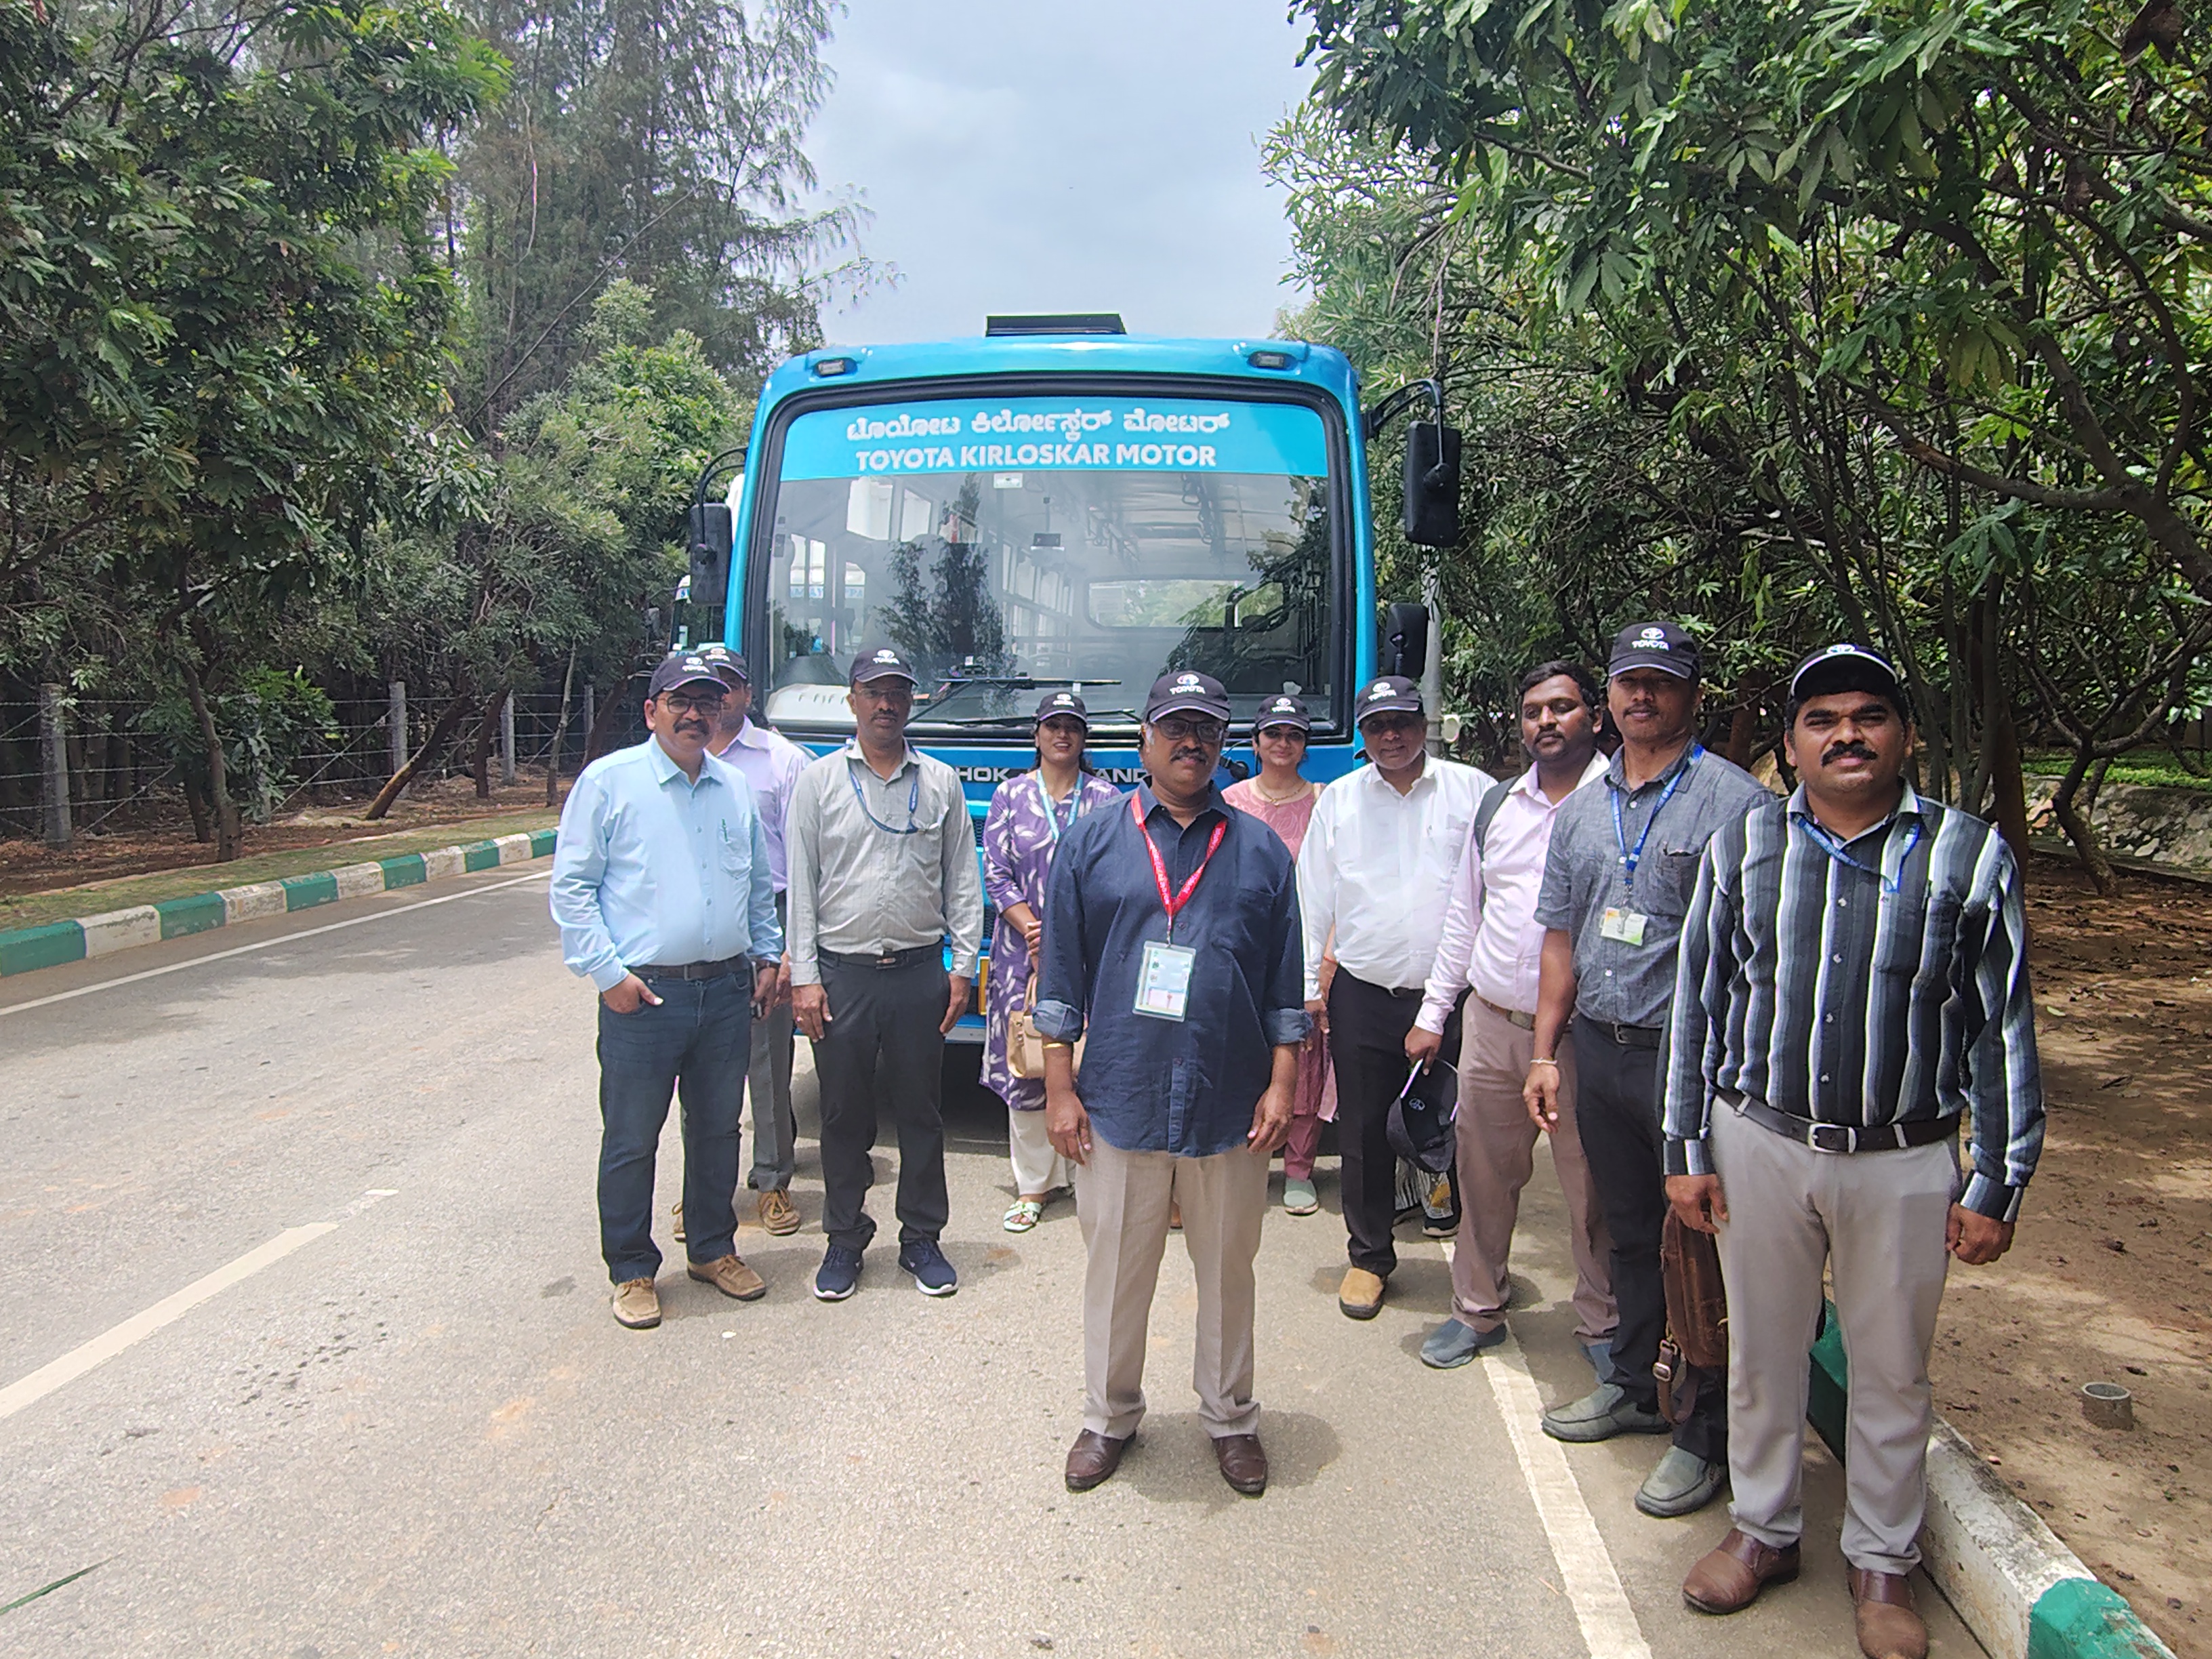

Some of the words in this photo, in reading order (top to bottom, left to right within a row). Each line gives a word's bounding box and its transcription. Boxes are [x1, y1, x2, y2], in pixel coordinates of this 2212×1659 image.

[856, 447, 955, 471] TOYOTA
[960, 444, 1110, 466] KIRLOSKAR
[1115, 443, 1216, 466] MOTOR
[956, 767, 1010, 781] HOK
[1094, 768, 1149, 783] AND
